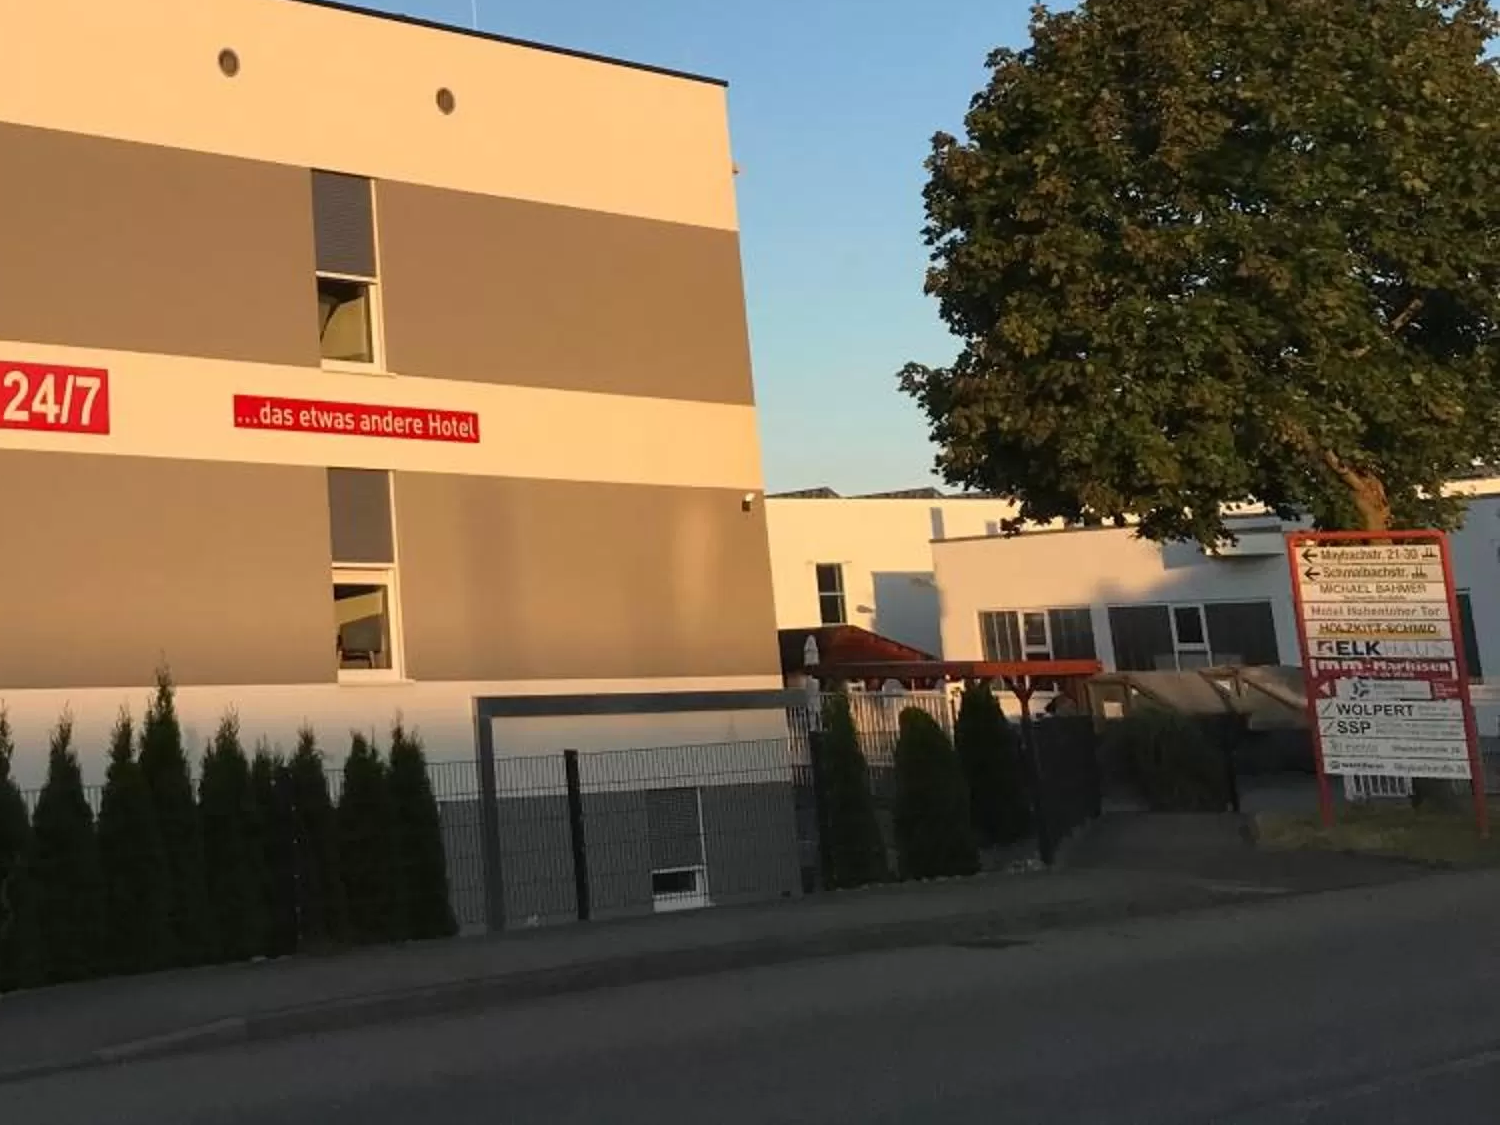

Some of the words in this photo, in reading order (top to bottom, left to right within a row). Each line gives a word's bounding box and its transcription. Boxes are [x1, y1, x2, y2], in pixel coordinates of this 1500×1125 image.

[1, 370, 101, 427] 24/7
[300, 405, 355, 431] etwas
[360, 409, 423, 436] andere
[428, 413, 475, 438] Hotel
[1319, 583, 1372, 594] MICHAEL
[1420, 606, 1441, 617] Tor
[1335, 640, 1381, 656] ELK
[1336, 704, 1414, 717] WOLPERT
[1336, 720, 1372, 735] SSP
